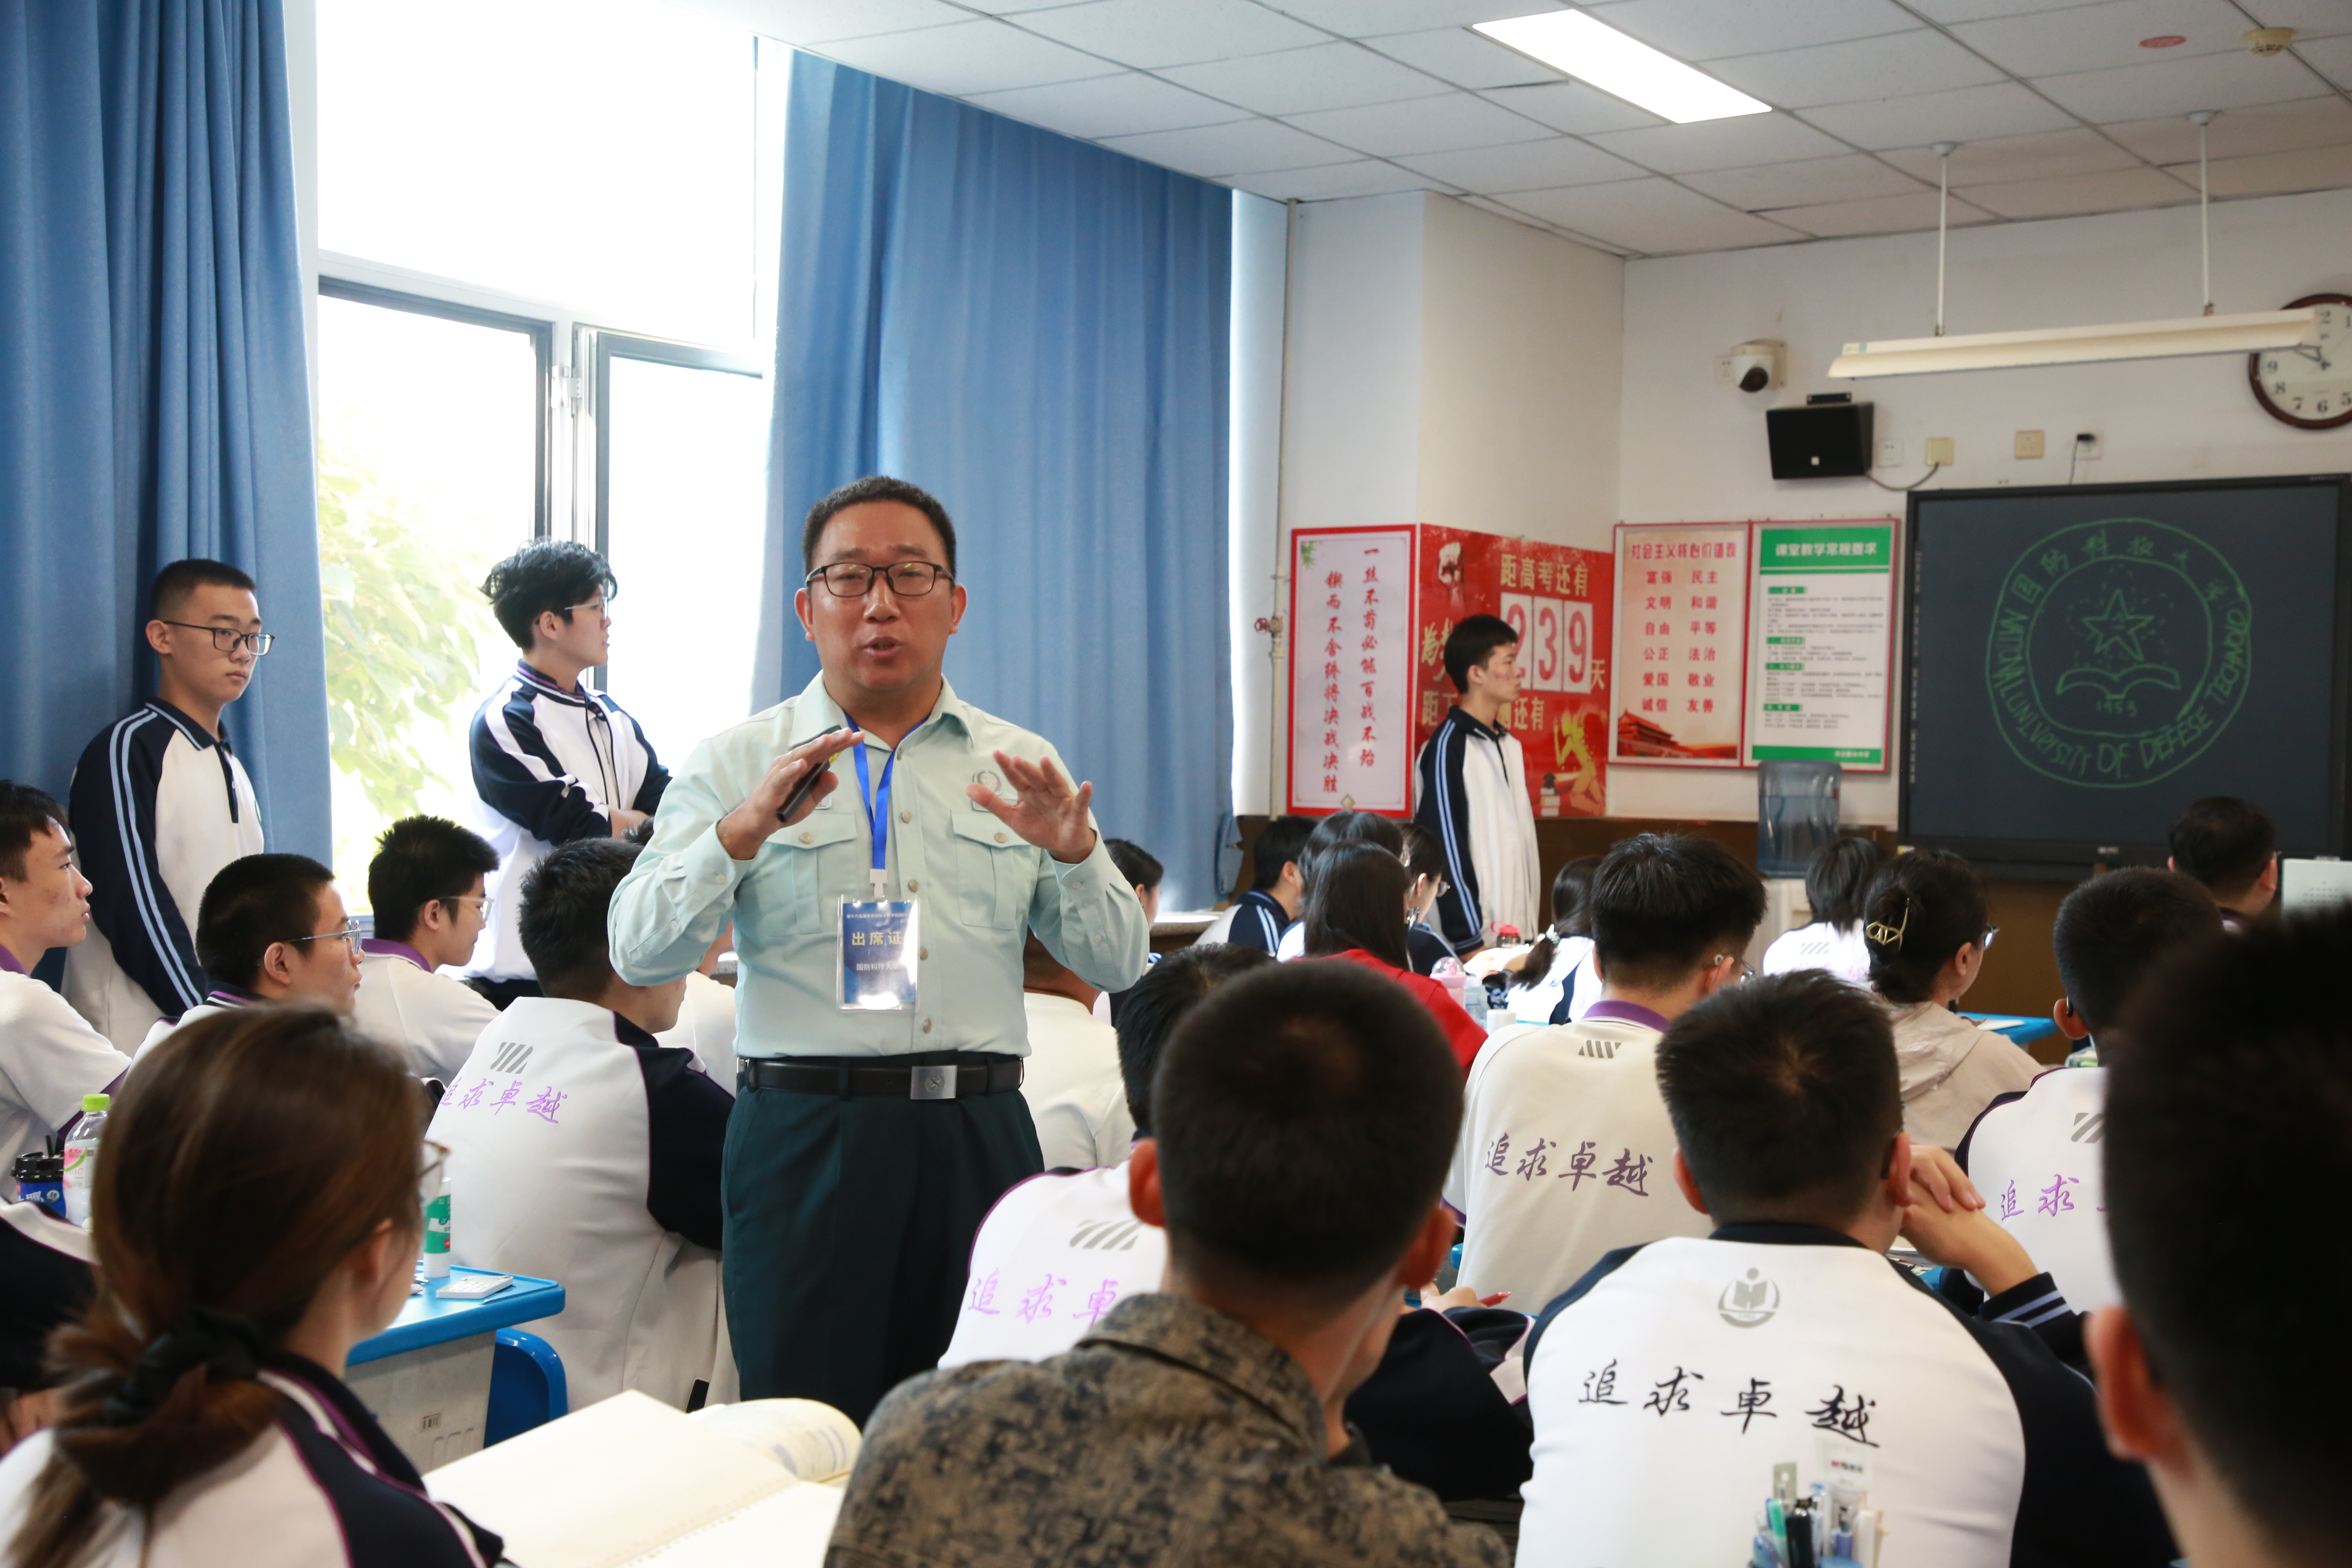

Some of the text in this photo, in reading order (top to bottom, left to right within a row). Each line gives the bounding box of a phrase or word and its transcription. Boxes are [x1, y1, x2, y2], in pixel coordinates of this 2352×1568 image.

[2293, 396, 2304, 410] 7
[2316, 399, 2328, 412] 6
[1632, 542, 1737, 560] 社会主义核心价值观
[1501, 554, 1588, 597] 距高考还有
[1646, 570, 1718, 584] 富强 民主
[1646, 595, 1717, 610] 文明 和谐
[1645, 621, 1716, 636] 自由 平等
[1360, 548, 1379, 767] 一丝不苟必能百战不殆
[1644, 647, 1716, 662] 公正 法治
[1323, 570, 1343, 792] 锲而不舍终将决战决胜
[1591, 659, 1606, 690] 天
[1643, 672, 1715, 687] 爱国 敬业
[1642, 698, 1714, 713] 诚信 友善
[2096, 742, 2130, 779] OF
[852, 931, 902, 946] 出席证
[440, 1076, 568, 1124] 追求卓越
[1485, 1132, 1653, 1197] 追求卓越
[2001, 1174, 2105, 1221] 追求
[968, 1267, 1118, 1327] 追求卓
[1578, 1358, 1880, 1448] 追求卓越
